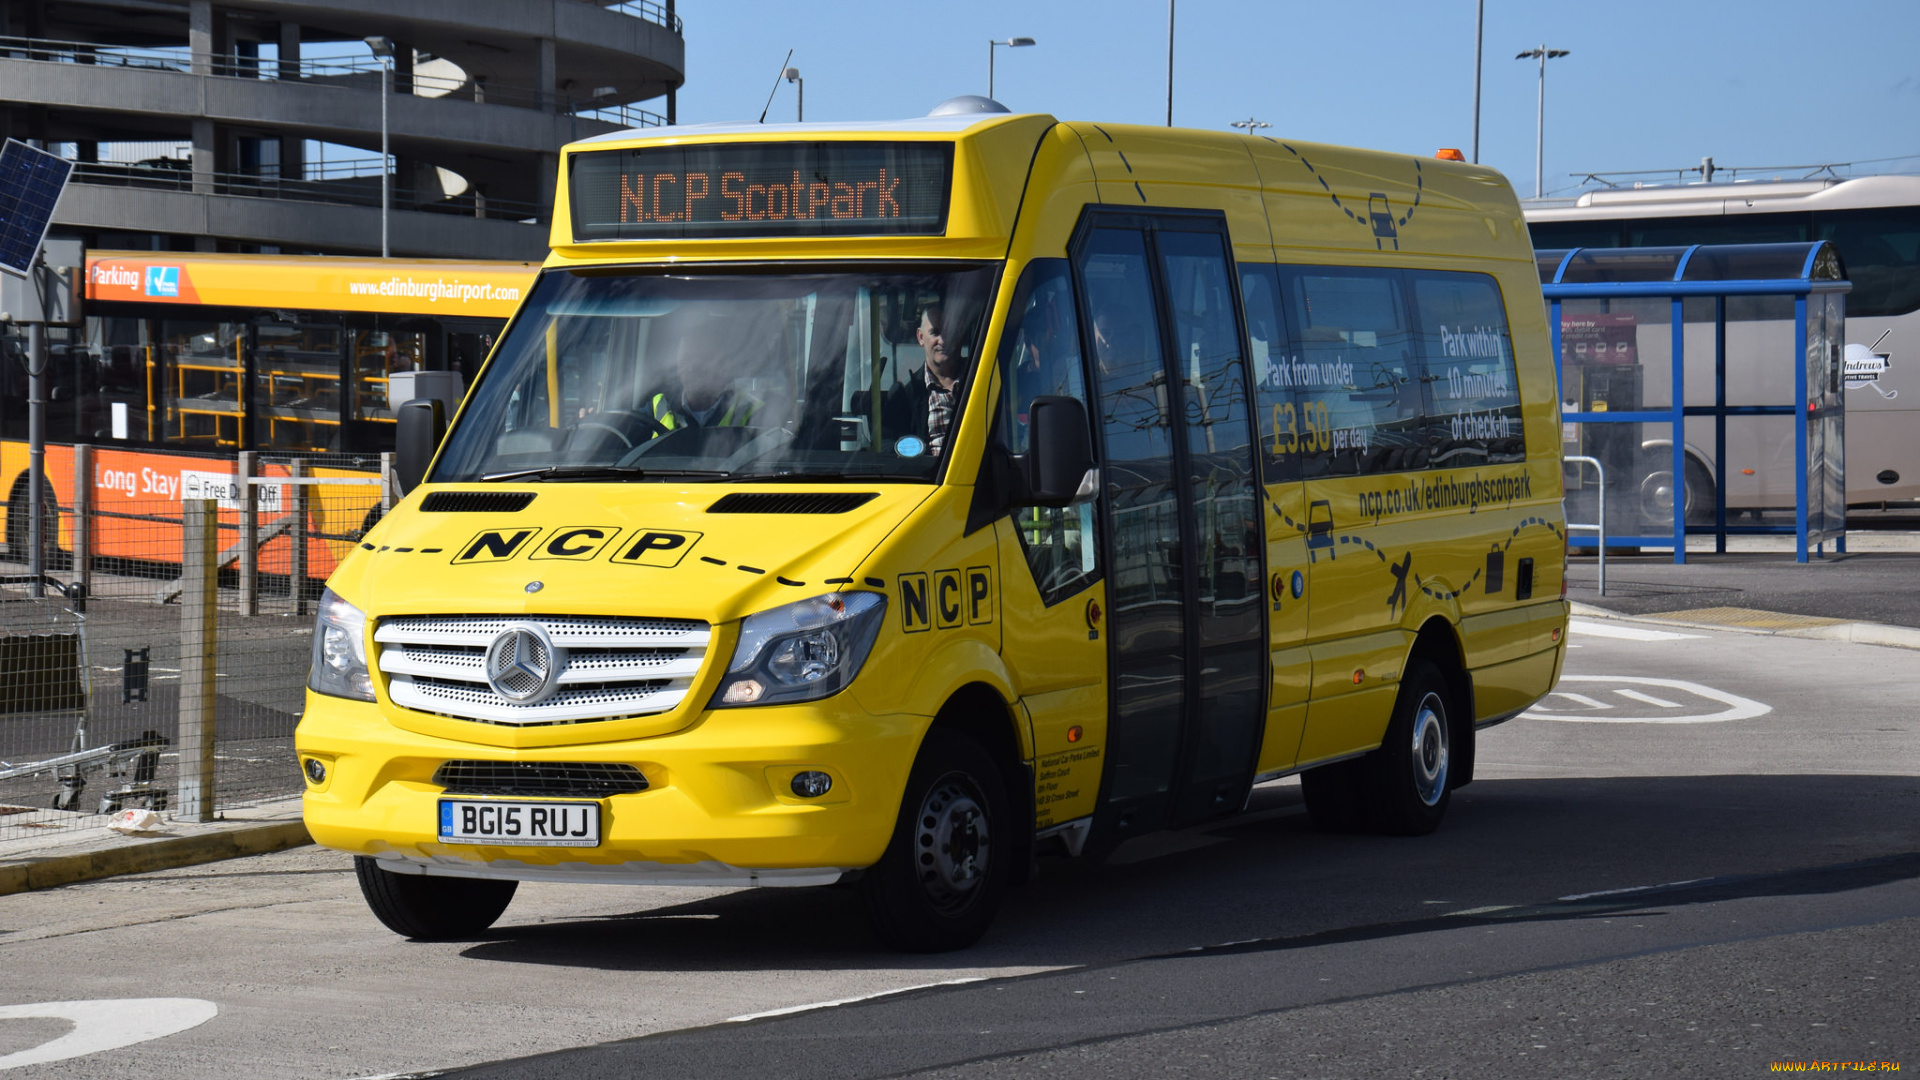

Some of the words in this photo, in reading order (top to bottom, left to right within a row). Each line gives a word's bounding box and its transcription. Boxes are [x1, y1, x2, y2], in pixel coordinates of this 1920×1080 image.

[619, 172, 709, 223] N.C.P
[721, 168, 900, 221] Scotpark
[92, 264, 140, 291] Parking
[349, 276, 520, 304] www.edinburghairport.com
[1440, 324, 1468, 357] Park
[1467, 324, 1500, 357] within
[1587, 320, 1595, 328] by
[1264, 355, 1292, 387] Park
[1292, 354, 1321, 386] from
[1321, 354, 1354, 386] under
[1447, 366, 1462, 399] 10
[1463, 369, 1507, 398] minutes
[1272, 400, 1330, 454] £3.50
[1333, 429, 1349, 459] per
[1350, 422, 1367, 456] day
[1451, 408, 1463, 441] of
[1464, 407, 1510, 441] check-in
[95, 462, 138, 498] Long
[142, 466, 180, 501] Stay
[203, 480, 226, 499] Free
[1358, 468, 1532, 526] ncp.co.uk/edinburghscotpark
[460, 528, 689, 562] NCP
[900, 572, 989, 627] NCP
[442, 825, 452, 834] GB
[461, 805, 522, 836] BG15
[530, 807, 589, 838] RUJ
